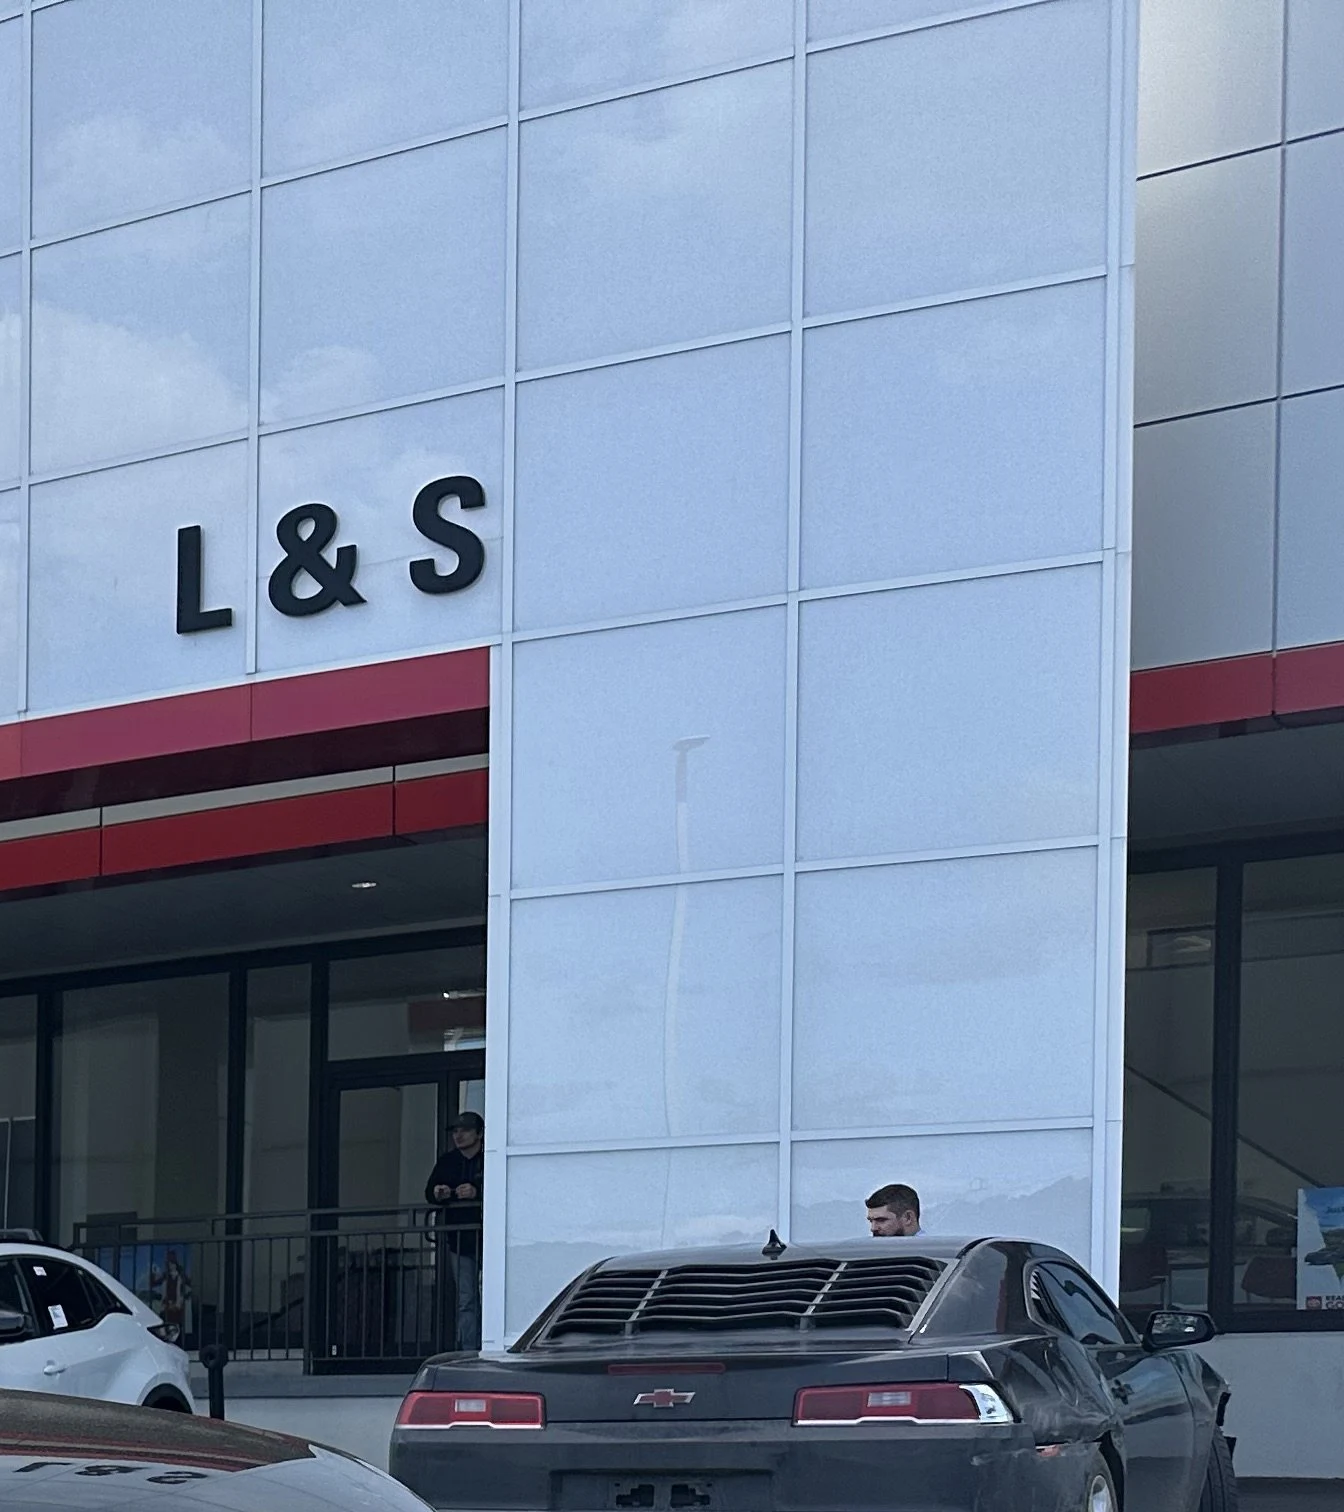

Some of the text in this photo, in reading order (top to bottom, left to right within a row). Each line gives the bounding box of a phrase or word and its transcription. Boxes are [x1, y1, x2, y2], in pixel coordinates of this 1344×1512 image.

[176, 475, 486, 634] L & S
